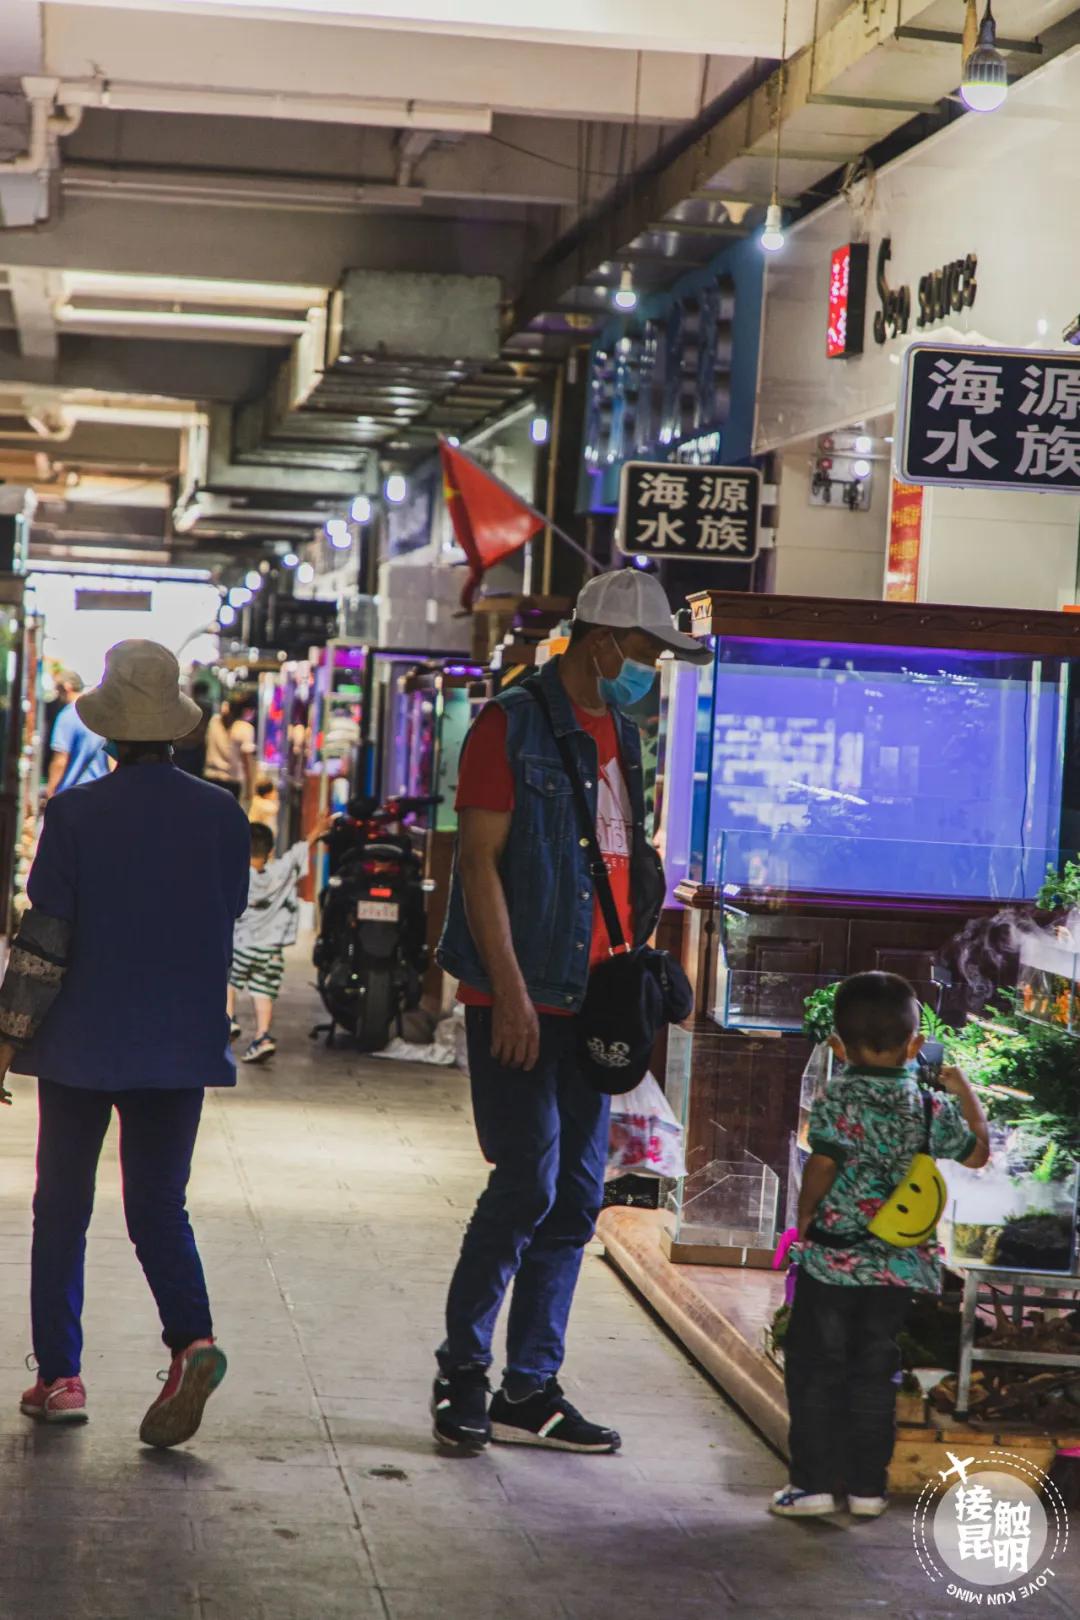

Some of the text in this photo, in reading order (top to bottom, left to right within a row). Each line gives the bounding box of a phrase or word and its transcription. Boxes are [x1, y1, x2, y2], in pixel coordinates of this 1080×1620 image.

[927, 358, 1080, 417] 海源
[923, 419, 1080, 478] 水族
[637, 472, 749, 512] 海源
[636, 515, 749, 552] 水族
